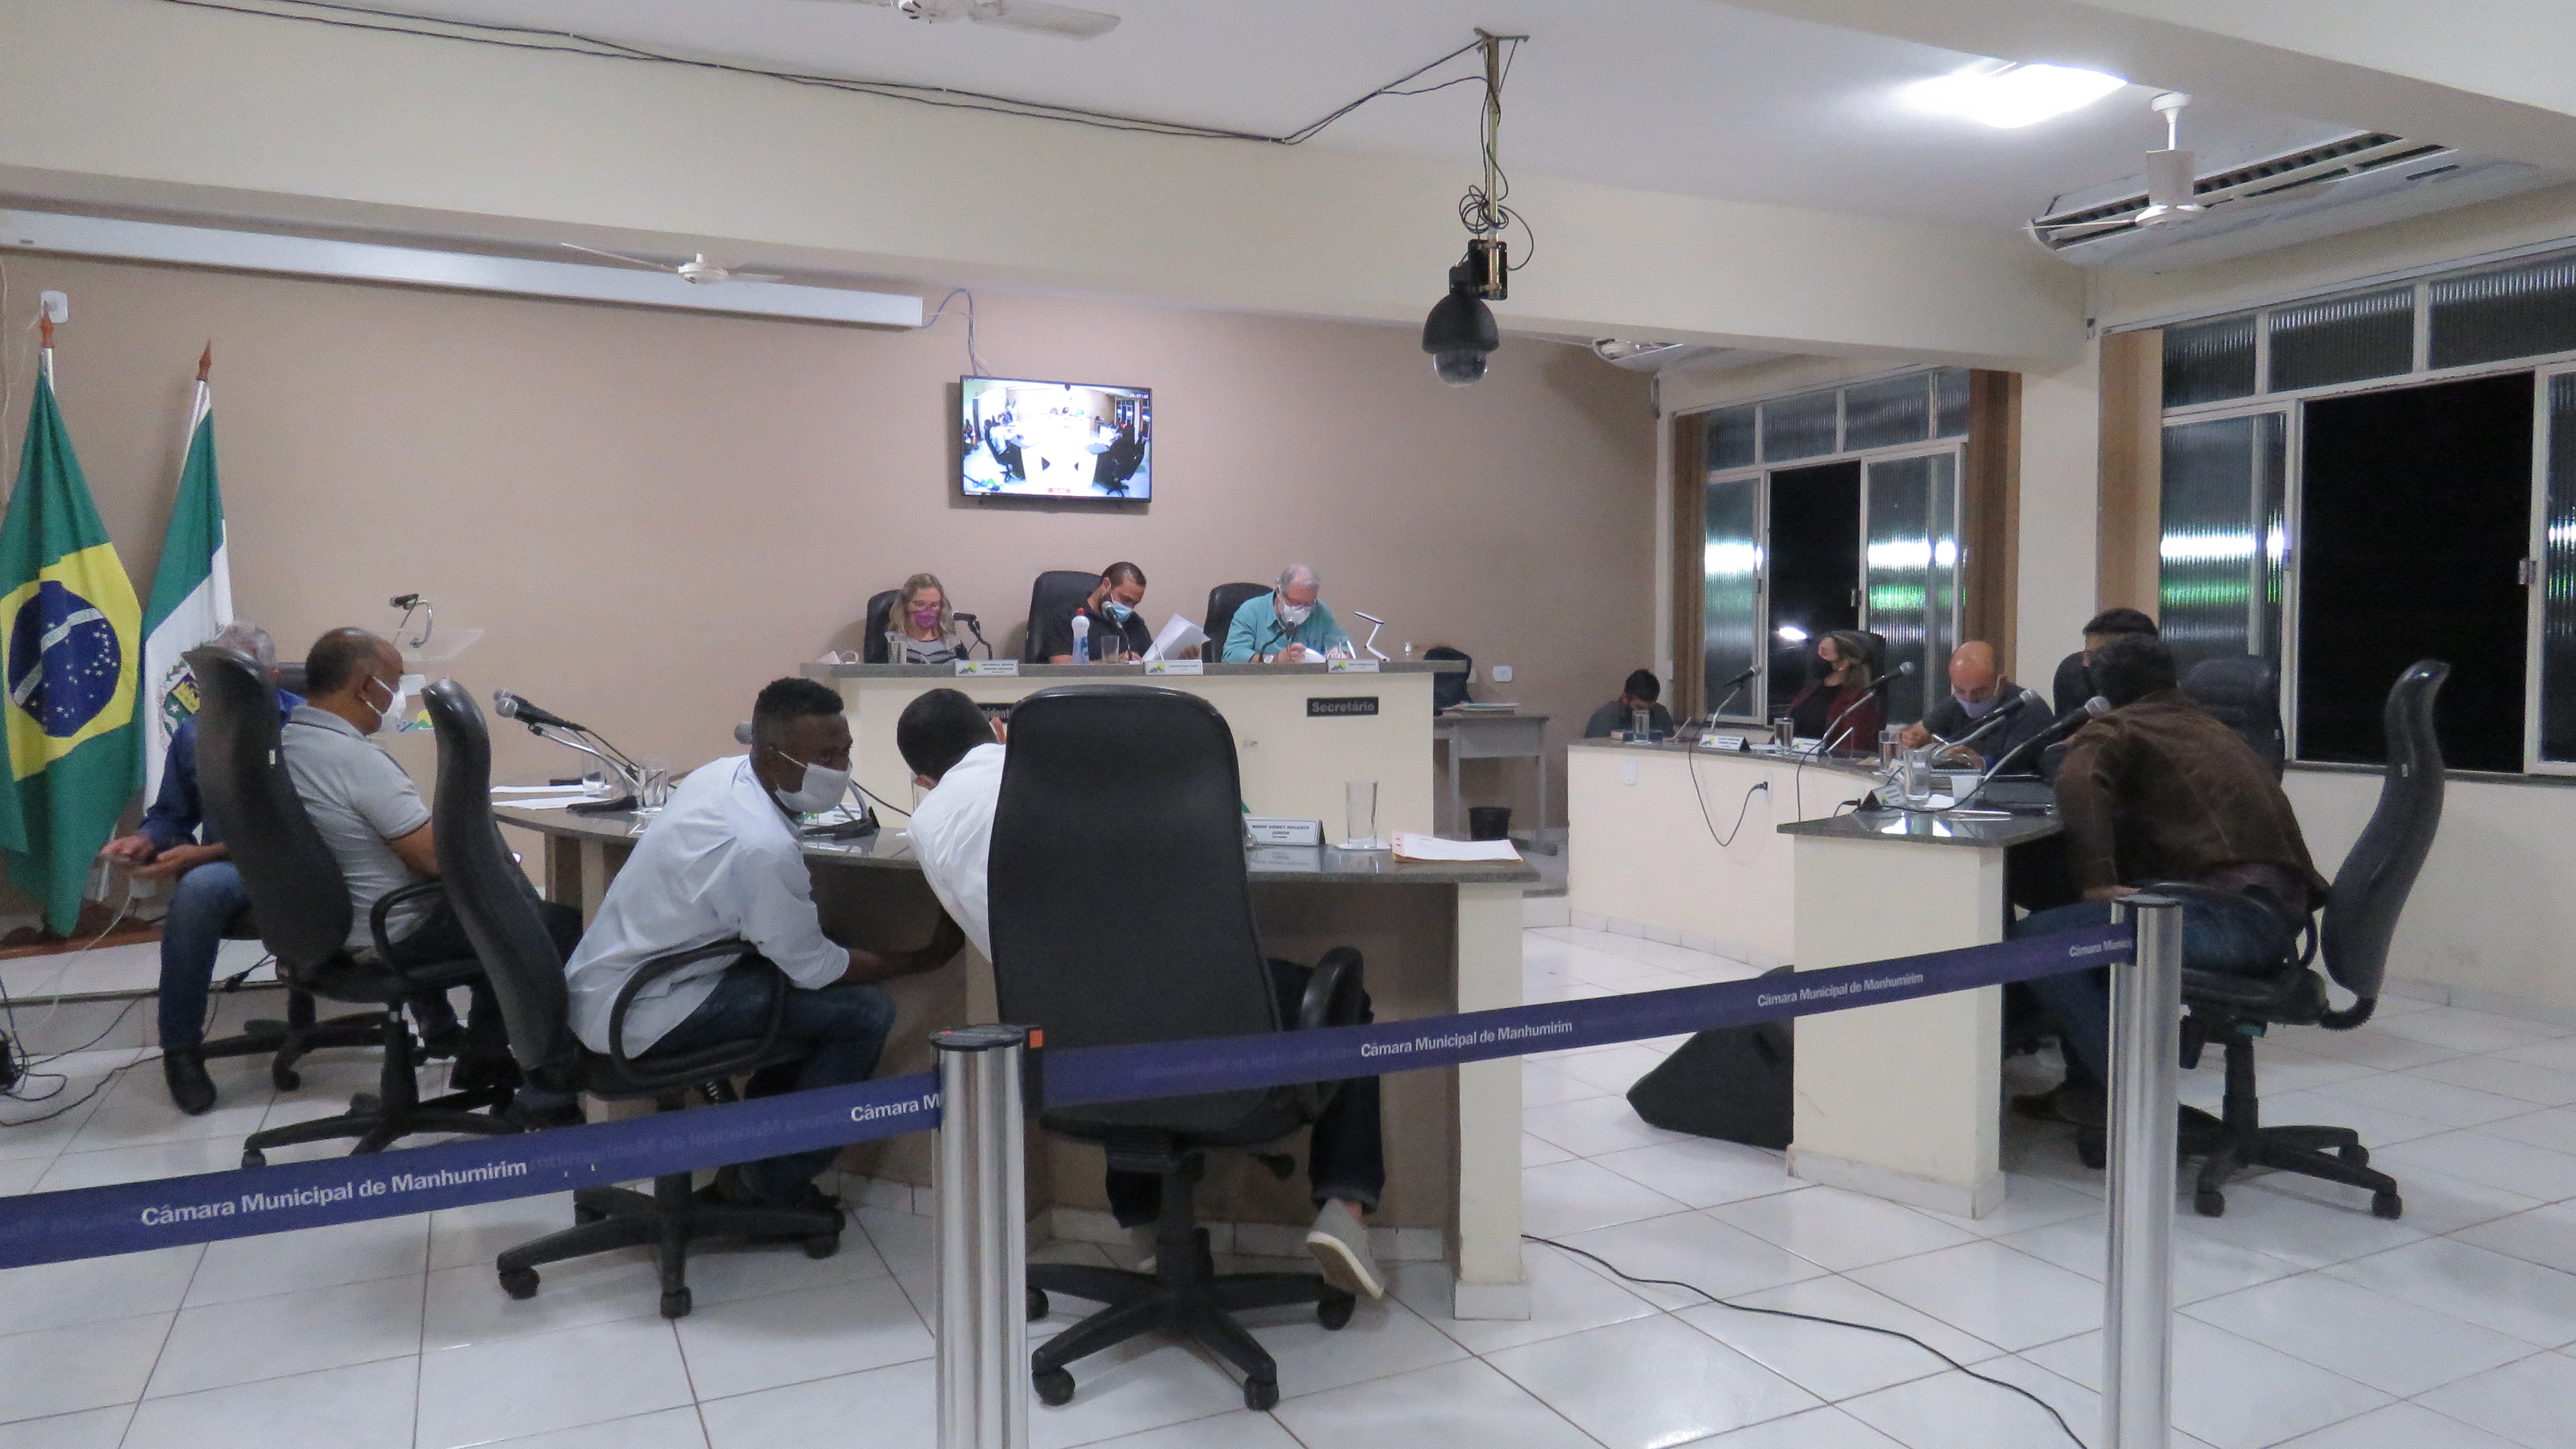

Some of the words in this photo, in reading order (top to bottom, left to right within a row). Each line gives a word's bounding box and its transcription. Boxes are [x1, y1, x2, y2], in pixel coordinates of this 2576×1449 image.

[1311, 700, 1375, 713] Secretário
[2070, 944, 2102, 956] Câmara
[1758, 992, 1797, 1007] Câmara
[1800, 983, 1848, 1001] Municipal
[1850, 982, 1862, 993] de
[1864, 974, 1924, 991] Manhumirim
[1361, 1041, 1412, 1058] Câmara
[1415, 1031, 1477, 1052] Municipal
[1480, 1030, 1495, 1043] de
[1498, 1021, 1573, 1040] Manhumirim
[851, 1100, 920, 1121] Câmara
[141, 1200, 236, 1226] Câmara
[242, 1180, 353, 1213] Municipal
[359, 1179, 386, 1197] de
[391, 1161, 527, 1193] Manhumirim
